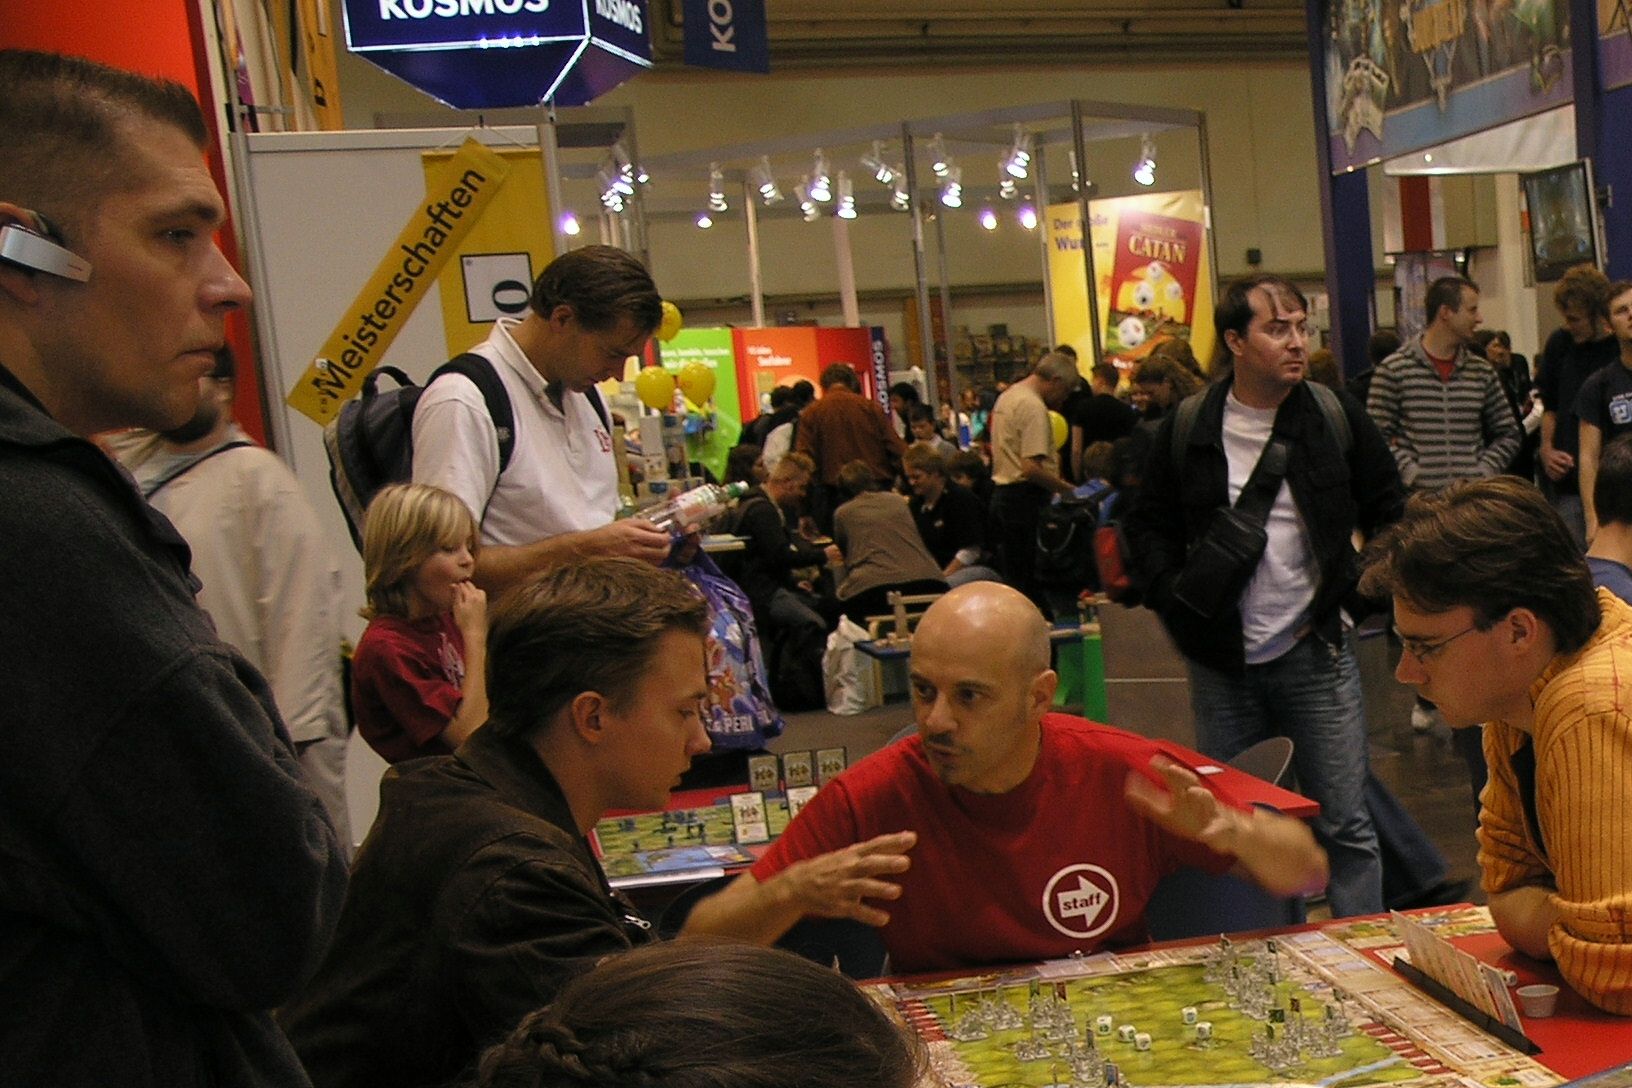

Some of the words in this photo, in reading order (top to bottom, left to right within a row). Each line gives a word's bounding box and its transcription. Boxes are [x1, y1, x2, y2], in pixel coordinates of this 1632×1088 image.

[1128, 233, 1187, 264] CATAN
[311, 169, 486, 401] Meisterschaften
[1063, 892, 1101, 911] staff
